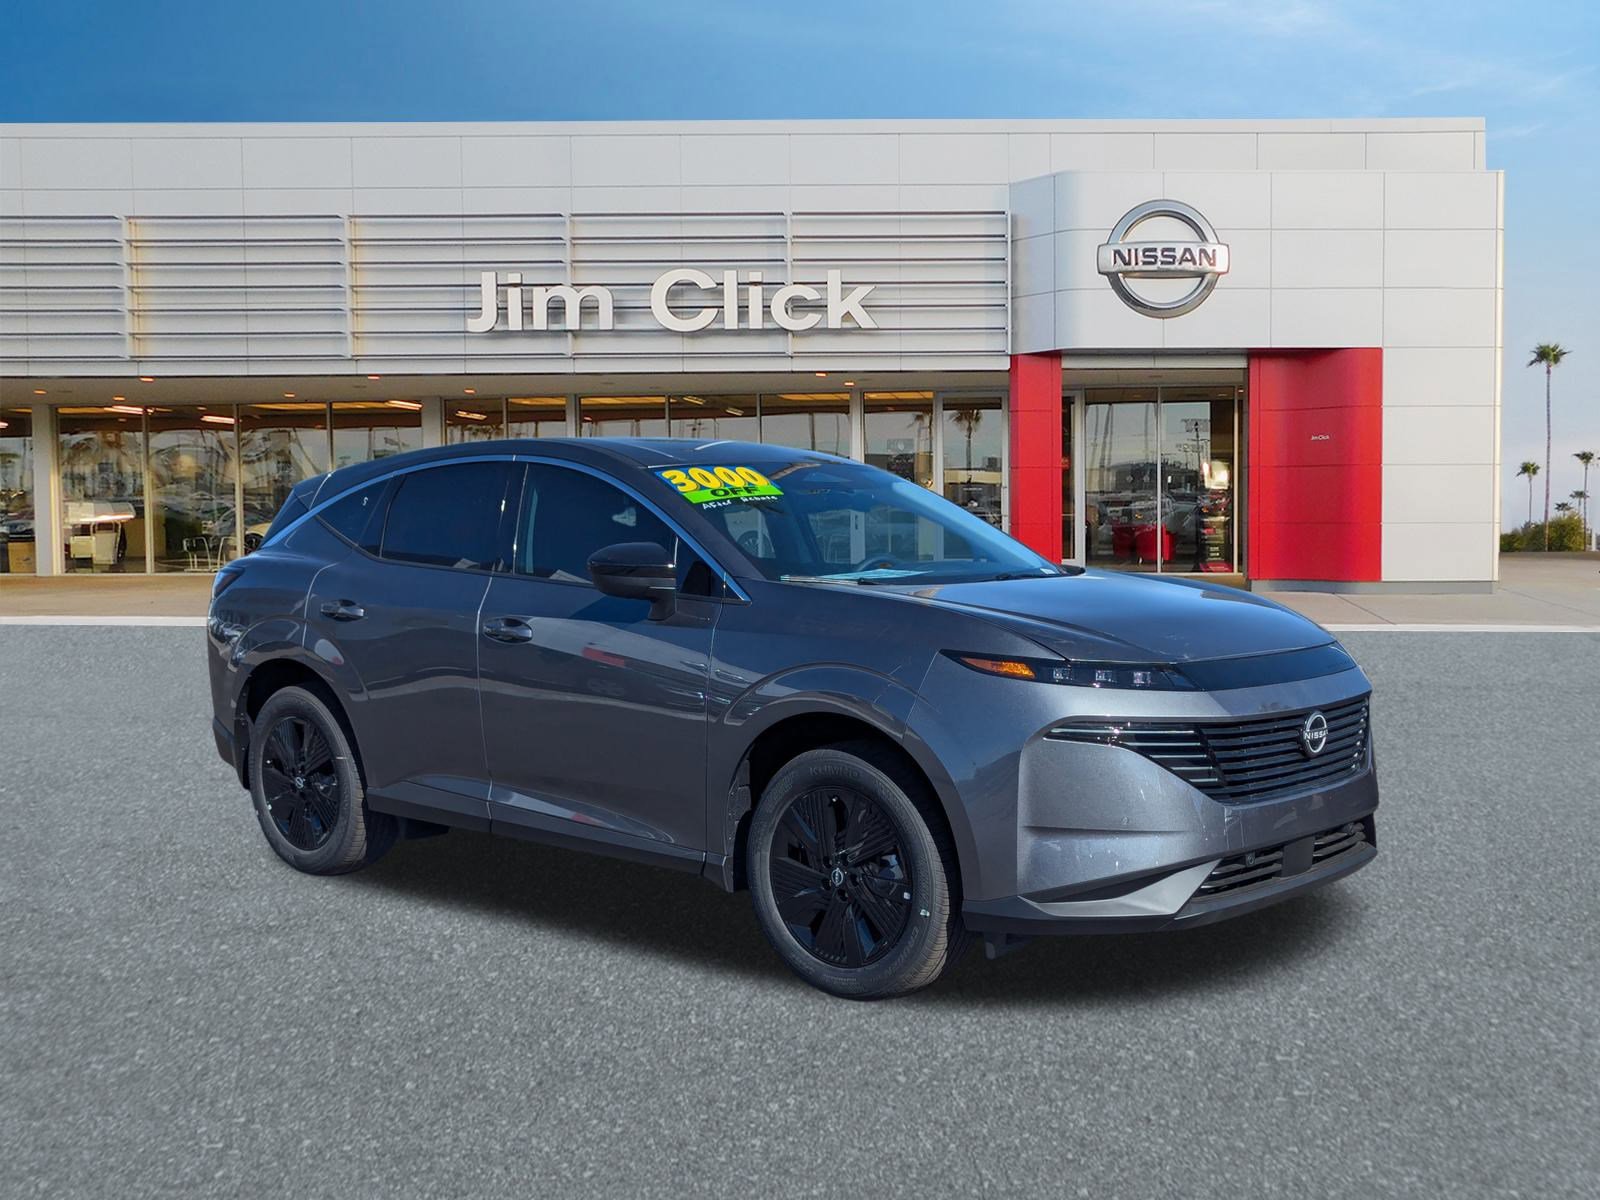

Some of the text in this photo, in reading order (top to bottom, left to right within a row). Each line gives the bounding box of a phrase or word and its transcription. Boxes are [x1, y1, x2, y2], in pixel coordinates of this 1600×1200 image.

[1111, 247, 1217, 267] NISSAN
[467, 268, 879, 334] Jim Click
[661, 466, 769, 492] 3000
[710, 486, 760, 497] OFF
